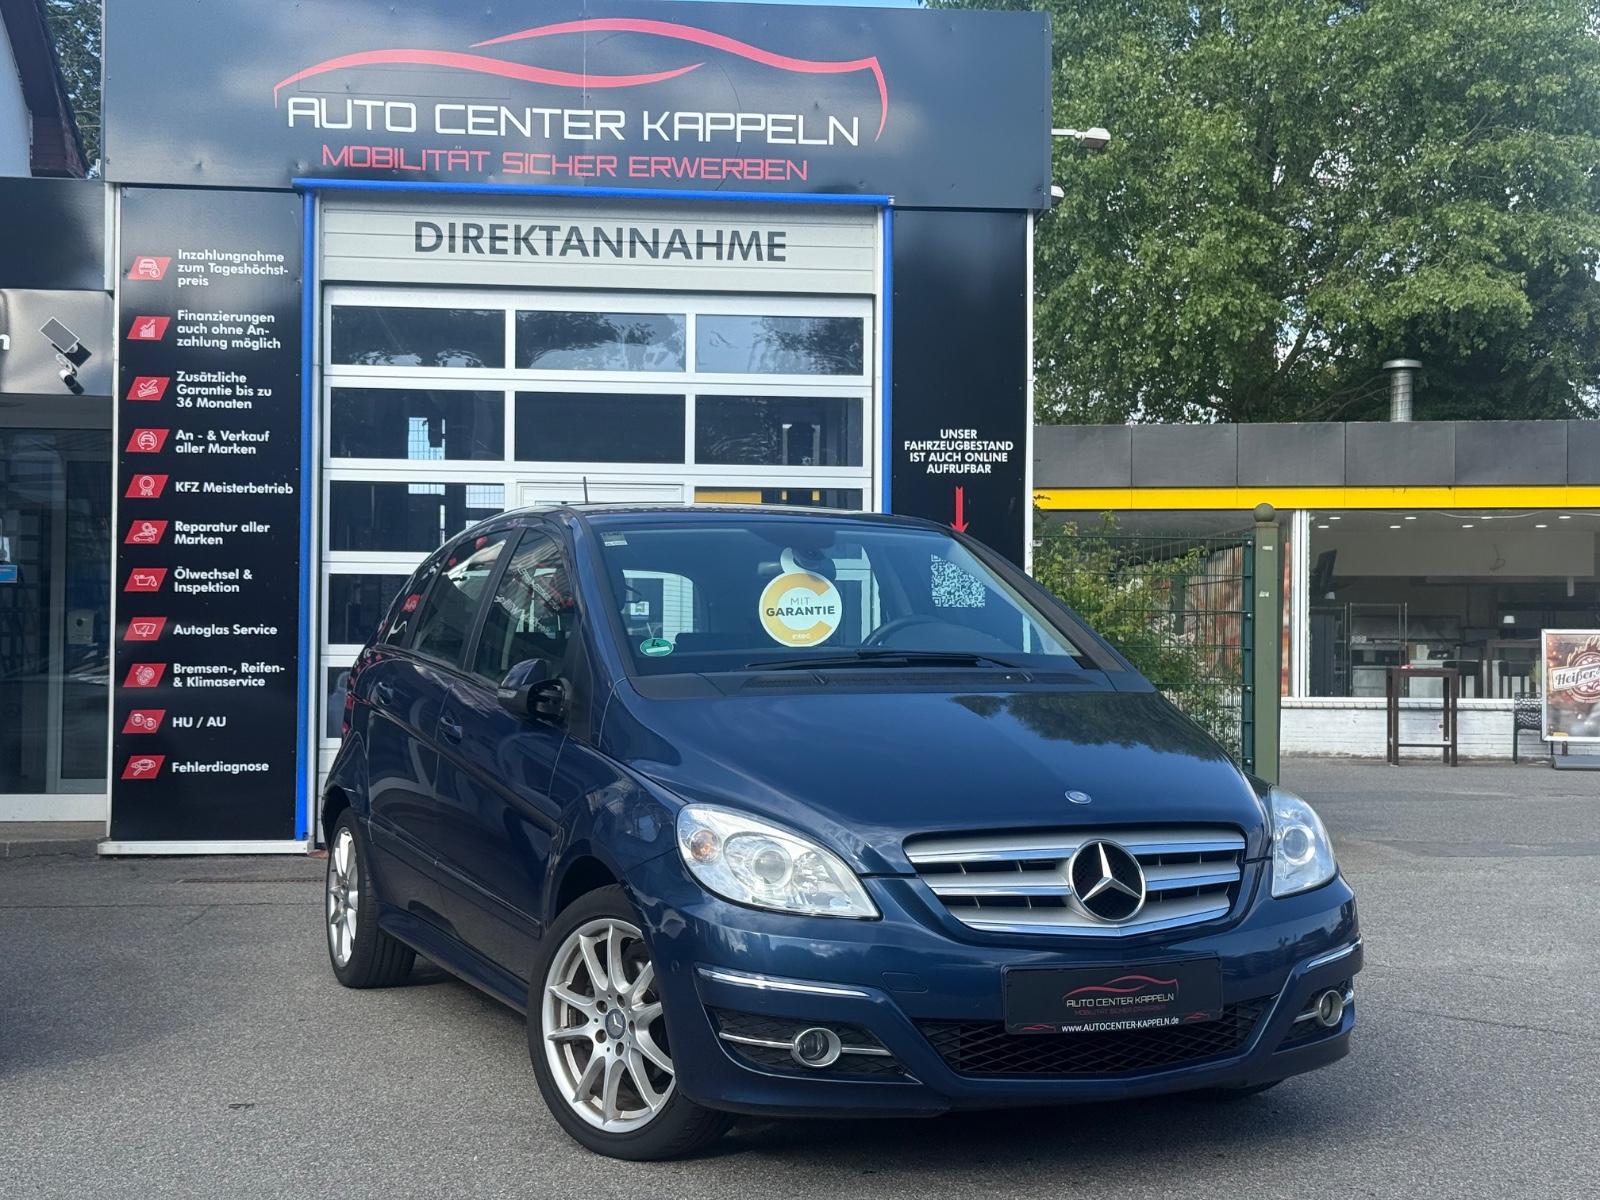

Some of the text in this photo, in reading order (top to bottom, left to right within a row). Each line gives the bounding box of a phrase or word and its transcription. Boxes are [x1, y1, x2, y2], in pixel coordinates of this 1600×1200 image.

[288, 97, 860, 147] AUTO CENTER KAPPELN
[322, 144, 808, 182] MOBILITÄT SICHER ERWERBEN
[414, 221, 787, 262] DIREKTANNAHME
[178, 249, 285, 263] Inzahlungnahme
[177, 262, 289, 276] zum Tageshöchst-
[177, 274, 209, 288] preis
[177, 309, 275, 324] Finanzierungen
[177, 323, 270, 336] auch ohne An-
[176, 335, 281, 351] zahlung möglich
[176, 371, 247, 385] Zusätzliche
[176, 384, 272, 397] Garantie bis zu
[176, 397, 253, 409] 36 Monaten
[175, 430, 194, 442] An
[206, 430, 217, 442] &
[220, 430, 270, 443] Verkauf
[940, 429, 977, 439] UNSER
[175, 442, 257, 455] aller Marken
[904, 441, 1014, 451] FAHRZEUGBESTAND
[909, 452, 1008, 462] IST AUCH ONLINE
[926, 464, 992, 474] AUFRUFBAR
[175, 482, 294, 495] KFZ Meisterbetrieb
[174, 521, 270, 534] Reparatur aller
[174, 534, 224, 545] Marken
[174, 566, 253, 580] Ölwechsel &
[174, 582, 240, 595] Inspektion
[791, 597, 810, 606] MIT
[766, 605, 836, 617] GARANTIE
[173, 624, 278, 638] Autoglas Service
[173, 662, 286, 674] Bremsen-, Reifen-
[173, 676, 266, 688] & Klimaservice
[172, 716, 227, 729] HU / AU
[172, 761, 270, 775] Fehlerdiagnose
[1066, 993, 1175, 1008] AUTO CENTER KAPPELN
[1061, 1016, 1179, 1032] www.AUTOCENTER-KAPPELN.de
